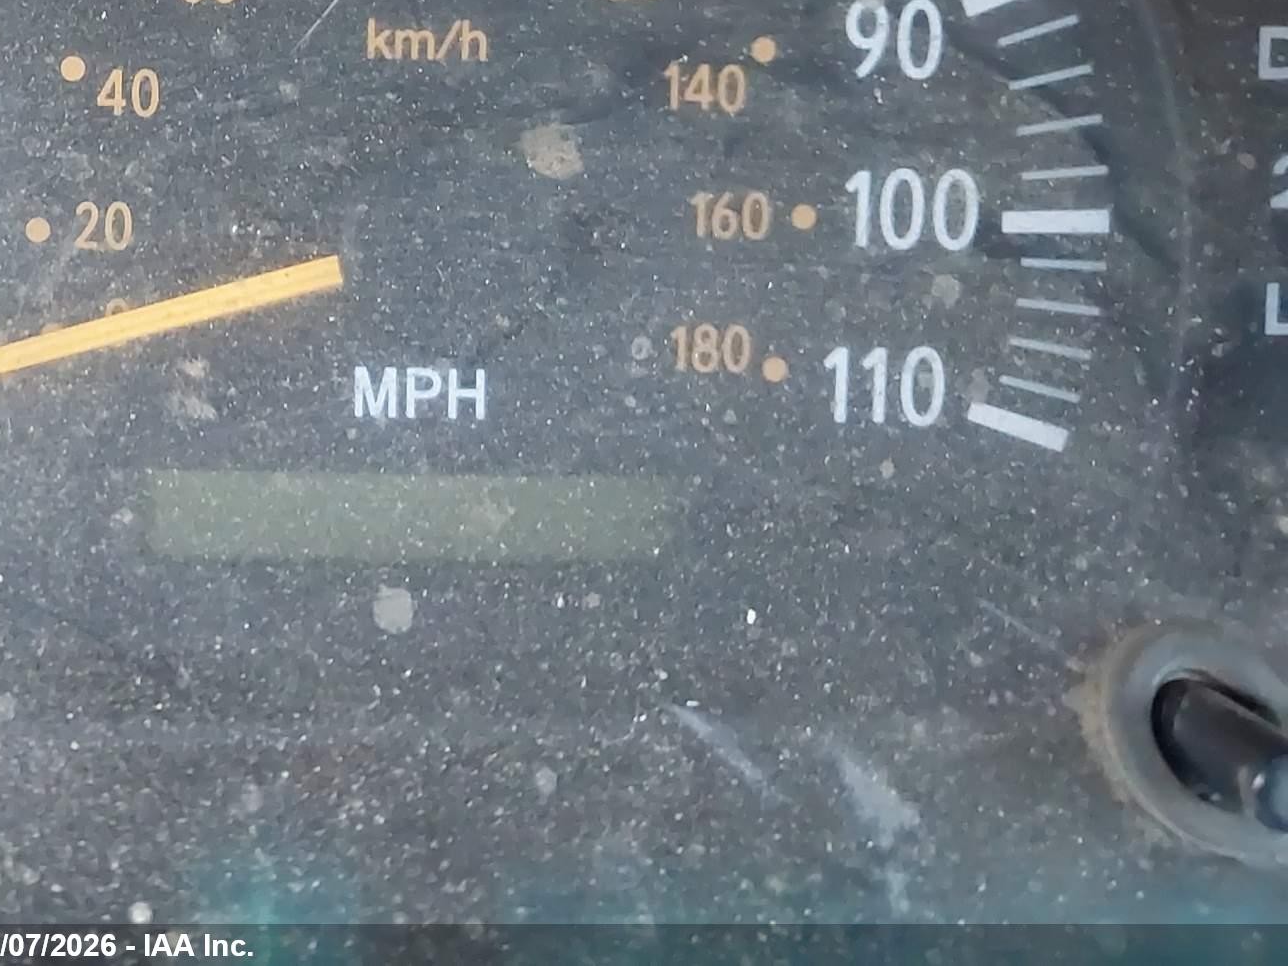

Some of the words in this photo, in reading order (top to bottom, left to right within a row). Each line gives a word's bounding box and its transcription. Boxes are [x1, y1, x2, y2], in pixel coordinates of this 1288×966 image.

[364, 17, 489, 63] km/h
[97, 67, 160, 118] 40
[664, 62, 748, 114] 140
[74, 200, 134, 252] 20
[692, 190, 772, 242] 160
[844, 166, 980, 251] 100
[672, 324, 752, 376] 180
[352, 365, 488, 421] MPH
[824, 344, 948, 428] 110
